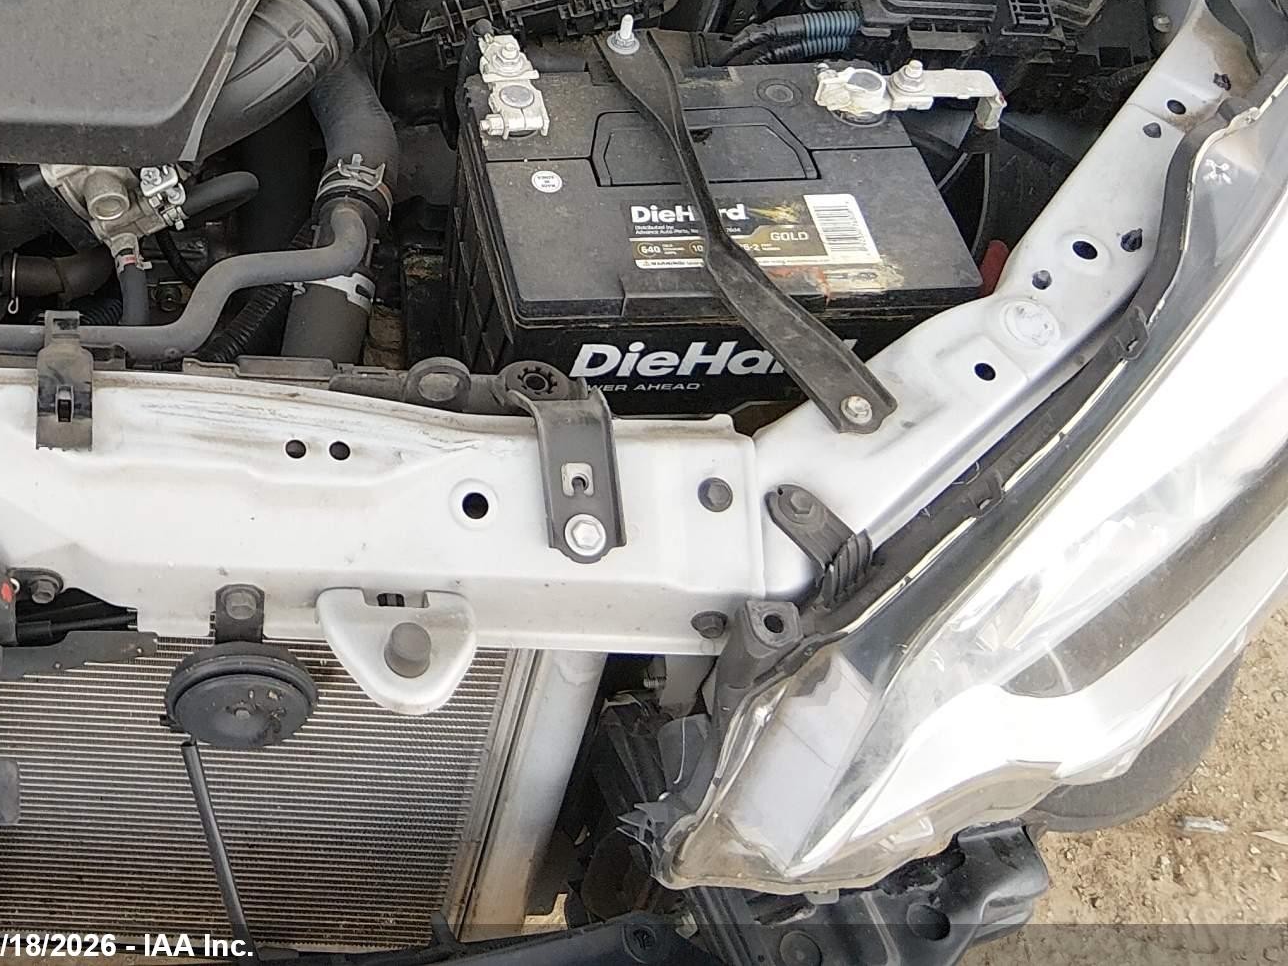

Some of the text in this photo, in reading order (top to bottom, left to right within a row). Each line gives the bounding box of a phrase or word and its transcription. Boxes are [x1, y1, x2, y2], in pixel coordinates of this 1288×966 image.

[630, 203, 747, 223] DieHrd
[770, 231, 809, 241] GOLD
[640, 245, 661, 253] 640
[692, 244, 704, 252] 10
[632, 382, 702, 392] AHEAD
